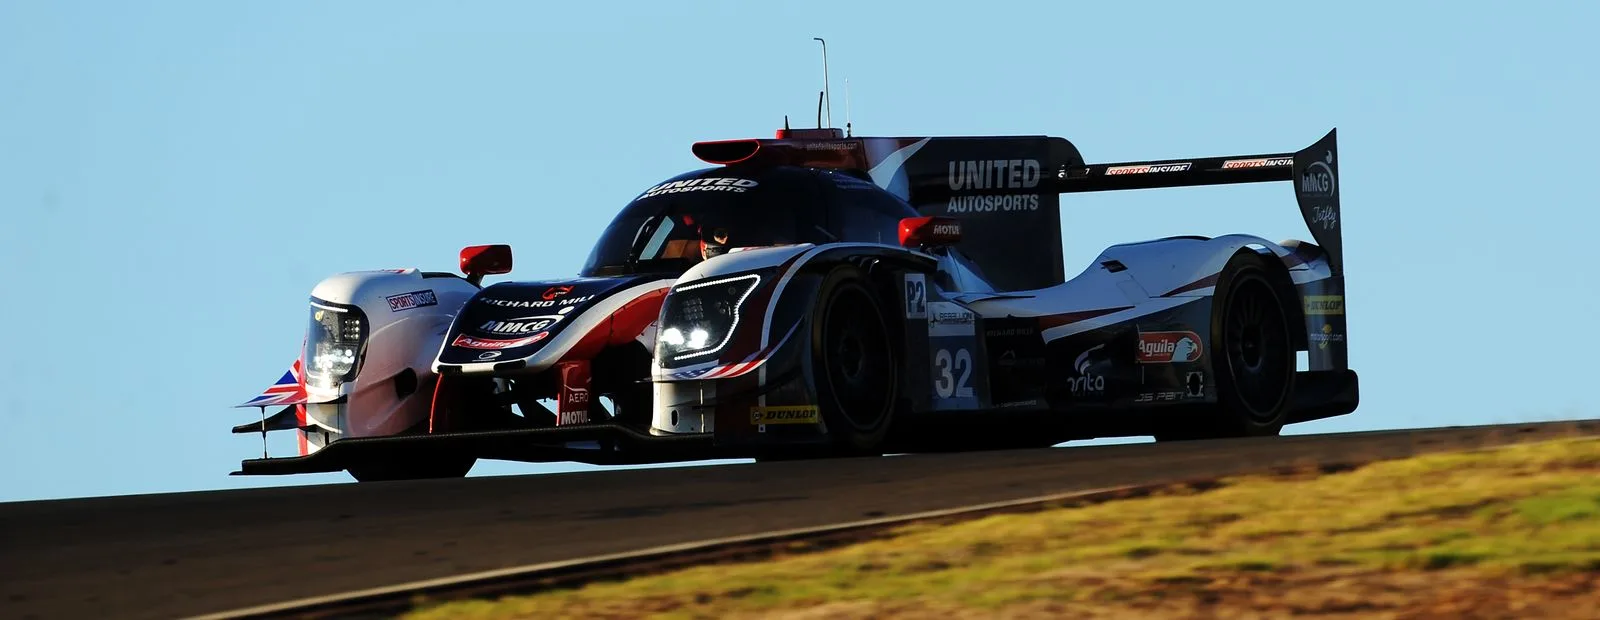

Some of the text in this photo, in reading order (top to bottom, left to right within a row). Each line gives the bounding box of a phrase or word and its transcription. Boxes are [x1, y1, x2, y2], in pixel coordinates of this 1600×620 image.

[948, 159, 1041, 190] UNITED
[1302, 173, 1329, 193] MMCG
[636, 186, 748, 201] AUTOSPORTS
[646, 177, 760, 194] UNITED
[947, 194, 1039, 213] AUTOSPORTS
[1312, 206, 1337, 229] Jetfly
[933, 225, 960, 235] MOTUL
[480, 297, 556, 308] RICHARD
[906, 281, 926, 313] P2
[480, 320, 551, 333] MMCG
[1138, 339, 1176, 357] Aguila
[935, 348, 975, 398] 32
[765, 409, 817, 420] DUNLOP
